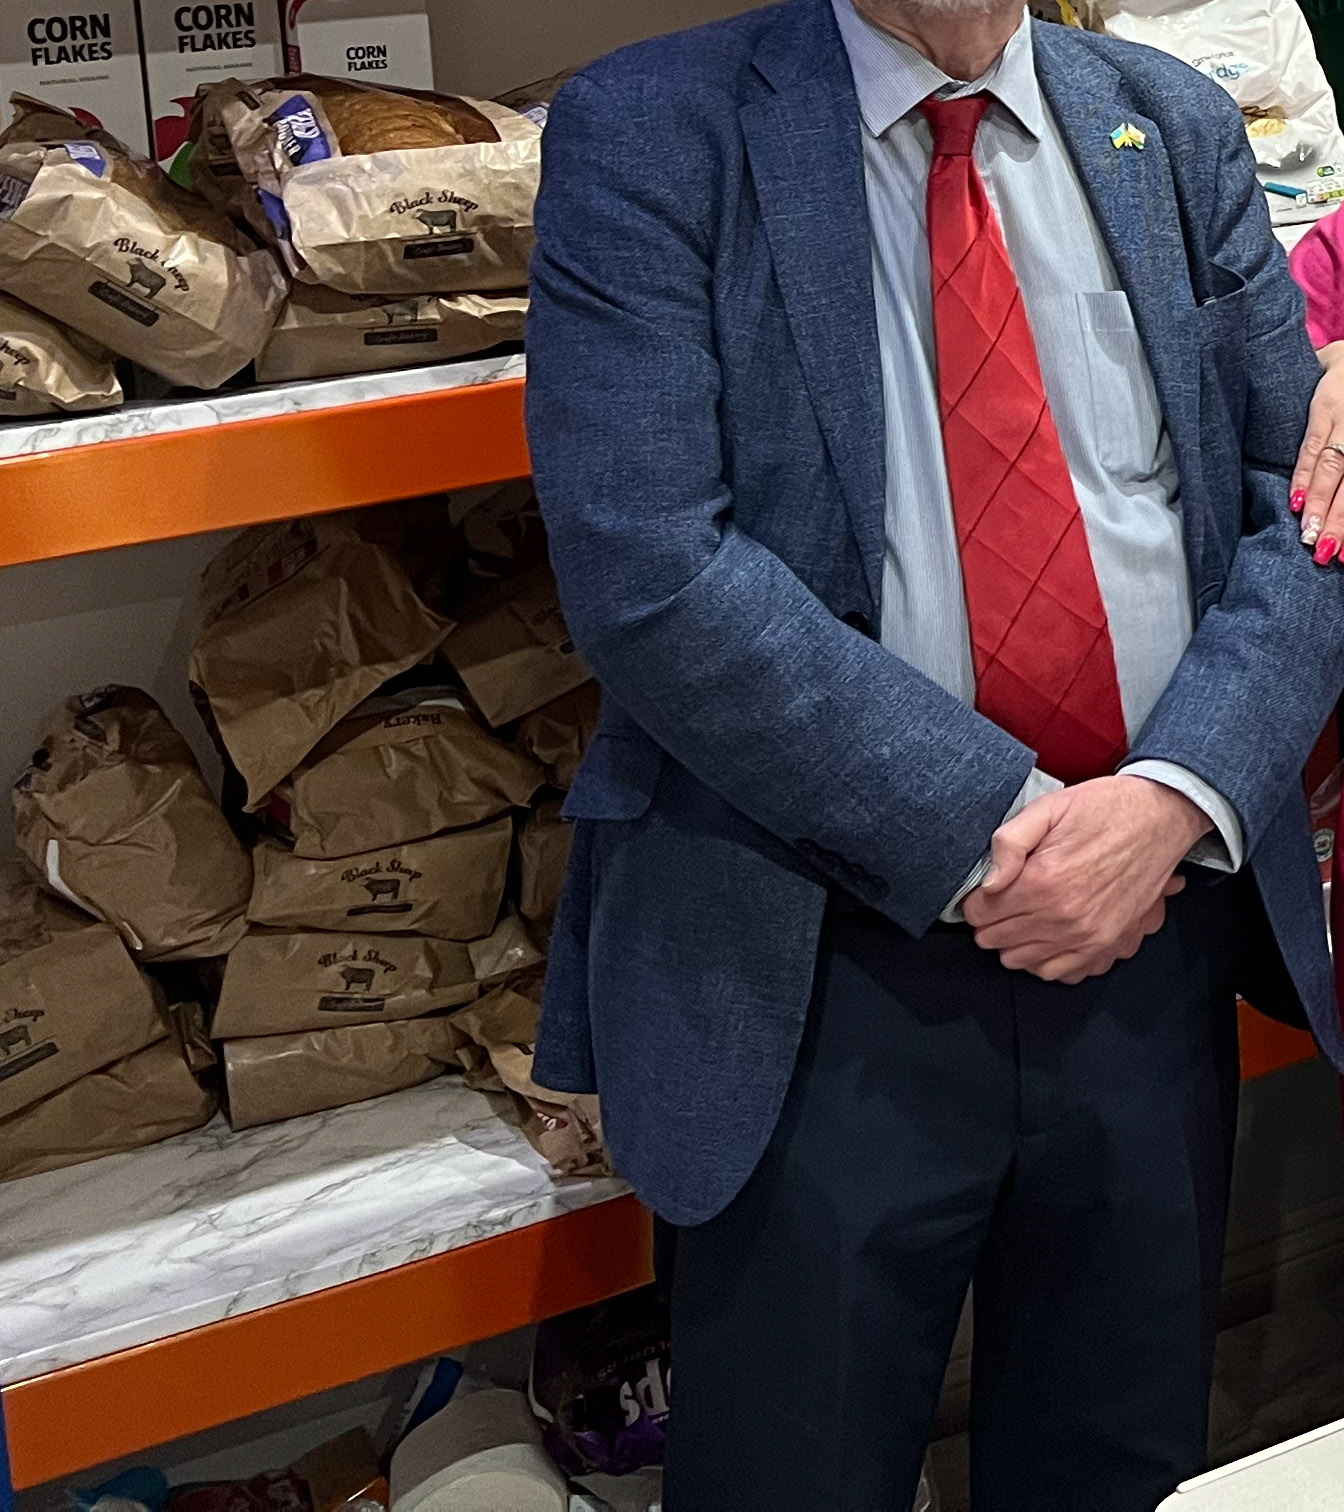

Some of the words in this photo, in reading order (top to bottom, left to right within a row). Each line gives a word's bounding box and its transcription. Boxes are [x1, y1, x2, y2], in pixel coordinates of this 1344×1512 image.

[27, 13, 112, 44] CORN
[174, 1, 255, 32] CORN
[177, 29, 257, 53] FLAKES
[346, 44, 388, 60] CORN
[31, 41, 113, 66] FLAKES
[347, 59, 388, 72] FLAKES
[389, 191, 434, 214] Black
[438, 189, 479, 212] Sheep
[114, 237, 160, 261] Black
[383, 712, 444, 730] Bakery
[341, 860, 384, 884] Black
